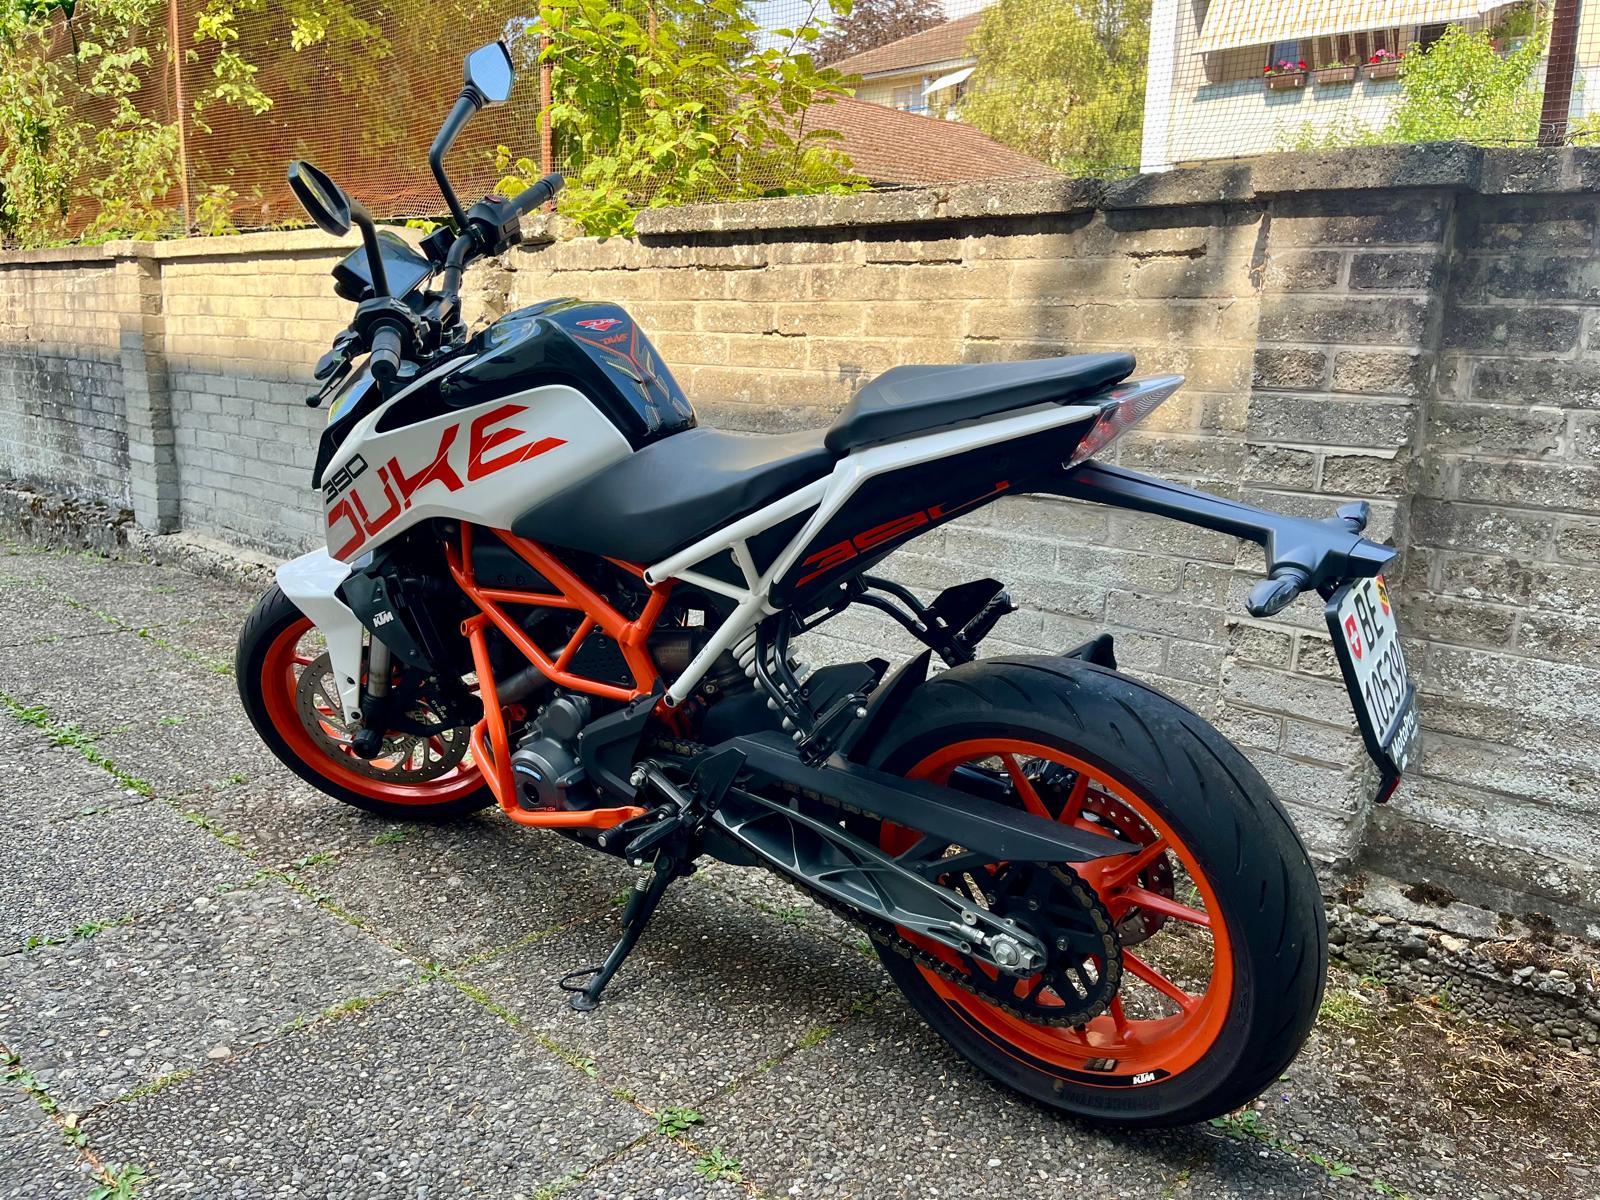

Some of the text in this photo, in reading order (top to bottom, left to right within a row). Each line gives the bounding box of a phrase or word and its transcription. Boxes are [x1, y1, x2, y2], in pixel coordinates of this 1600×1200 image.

[322, 453, 368, 504] 390
[328, 404, 568, 564] DUKE
[373, 610, 394, 628] KTM
[1354, 580, 1384, 652] BE
[1392, 710, 1415, 763] MotoPro
[1133, 1072, 1155, 1085] KTM
